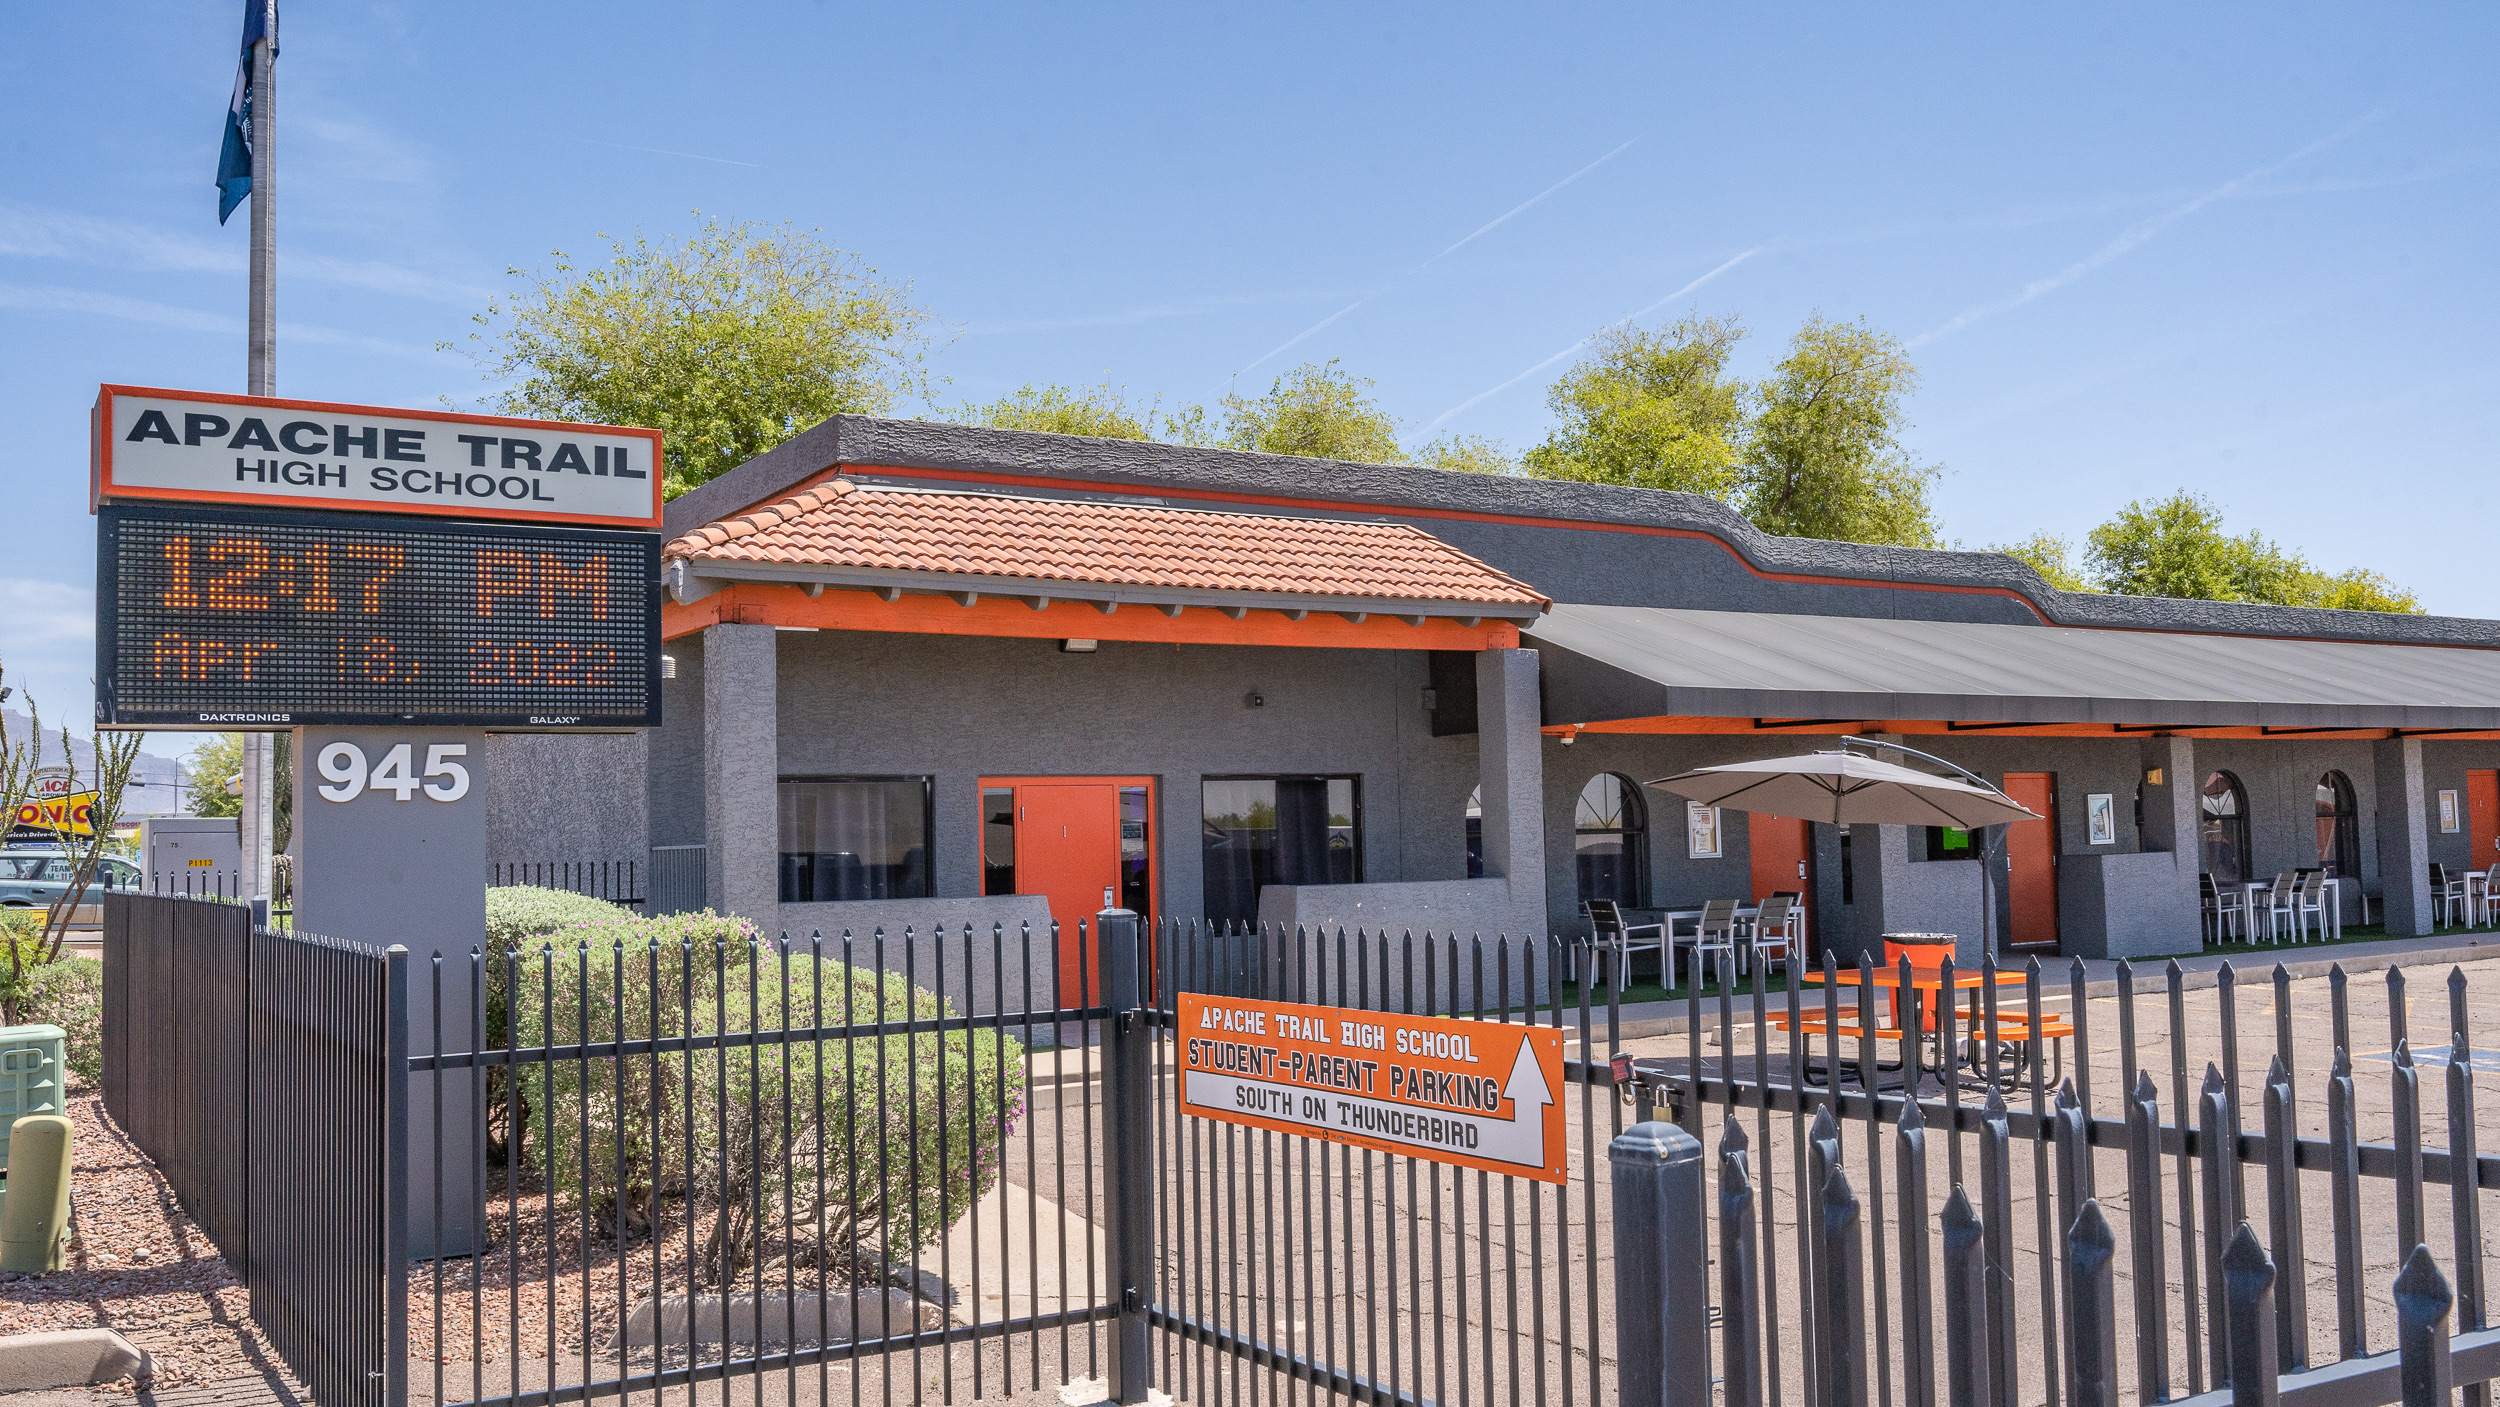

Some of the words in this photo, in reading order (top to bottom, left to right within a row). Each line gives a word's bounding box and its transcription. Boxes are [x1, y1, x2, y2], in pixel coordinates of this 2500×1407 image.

[126, 410, 427, 463] APACHE
[457, 434, 647, 480] TRAIL
[235, 457, 347, 489] HIGH
[369, 466, 555, 502] SCHOOL
[163, 536, 404, 613] 12:17
[478, 550, 608, 619] PM
[469, 640, 615, 686] 2022
[199, 713, 291, 722] DAKTRONICS
[317, 741, 470, 802] 945
[1200, 1006, 1266, 1036] APACHE
[1274, 1013, 1331, 1044] TRAIL
[1340, 1020, 1386, 1052] HIGH
[1395, 1027, 1479, 1063] SCHOOL
[1187, 1037, 1379, 1094] STUDENT-PARENT
[1389, 1063, 1499, 1113] PARKING
[1236, 1084, 1293, 1117] SOUTH
[1302, 1095, 1327, 1122] ON
[1336, 1100, 1479, 1150] THUNDERBIRD
